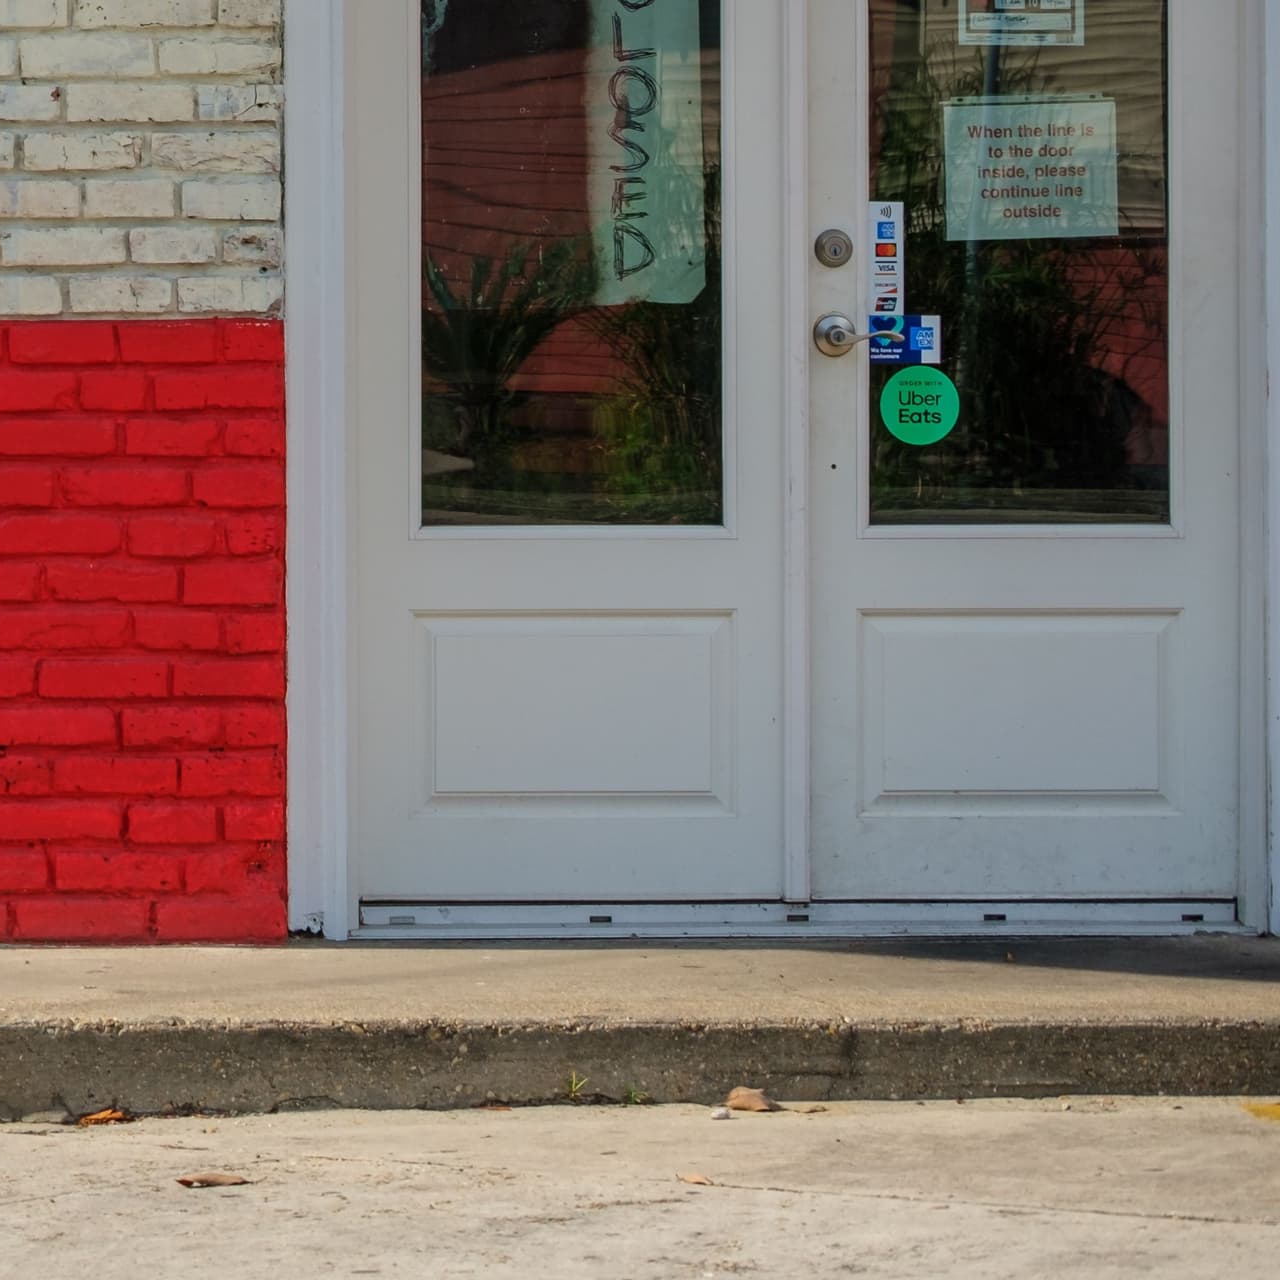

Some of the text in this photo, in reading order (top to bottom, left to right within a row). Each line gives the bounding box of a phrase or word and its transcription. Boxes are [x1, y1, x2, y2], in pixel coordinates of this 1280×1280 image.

[968, 123, 1095, 139] When the line is
[988, 144, 1074, 159] to the door
[978, 164, 1086, 181] inside, please
[981, 184, 1083, 199] continue line
[1003, 204, 1062, 218] outside
[878, 264, 895, 272] VISA
[898, 390, 942, 406] Uber
[898, 408, 942, 424] Eats
